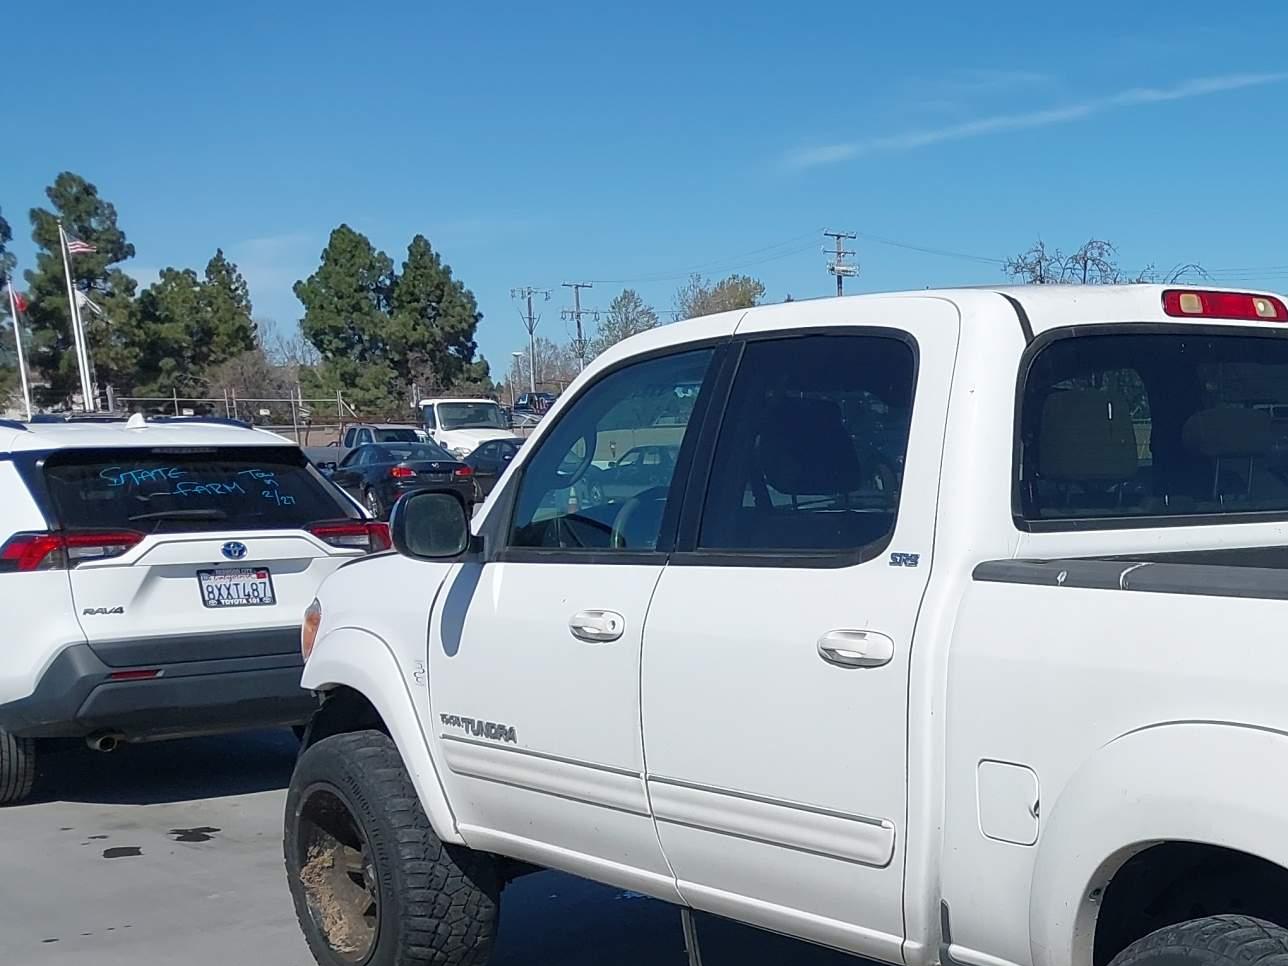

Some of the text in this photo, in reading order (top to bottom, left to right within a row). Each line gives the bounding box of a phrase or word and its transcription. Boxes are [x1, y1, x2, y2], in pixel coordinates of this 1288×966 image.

[99, 467, 188, 487] STATE
[172, 481, 246, 497] FARM
[205, 582, 268, 600] 8XXT487
[83, 606, 125, 615] RAV4
[220, 598, 248, 606] TOYOTA
[461, 718, 518, 744] TUNDRA
